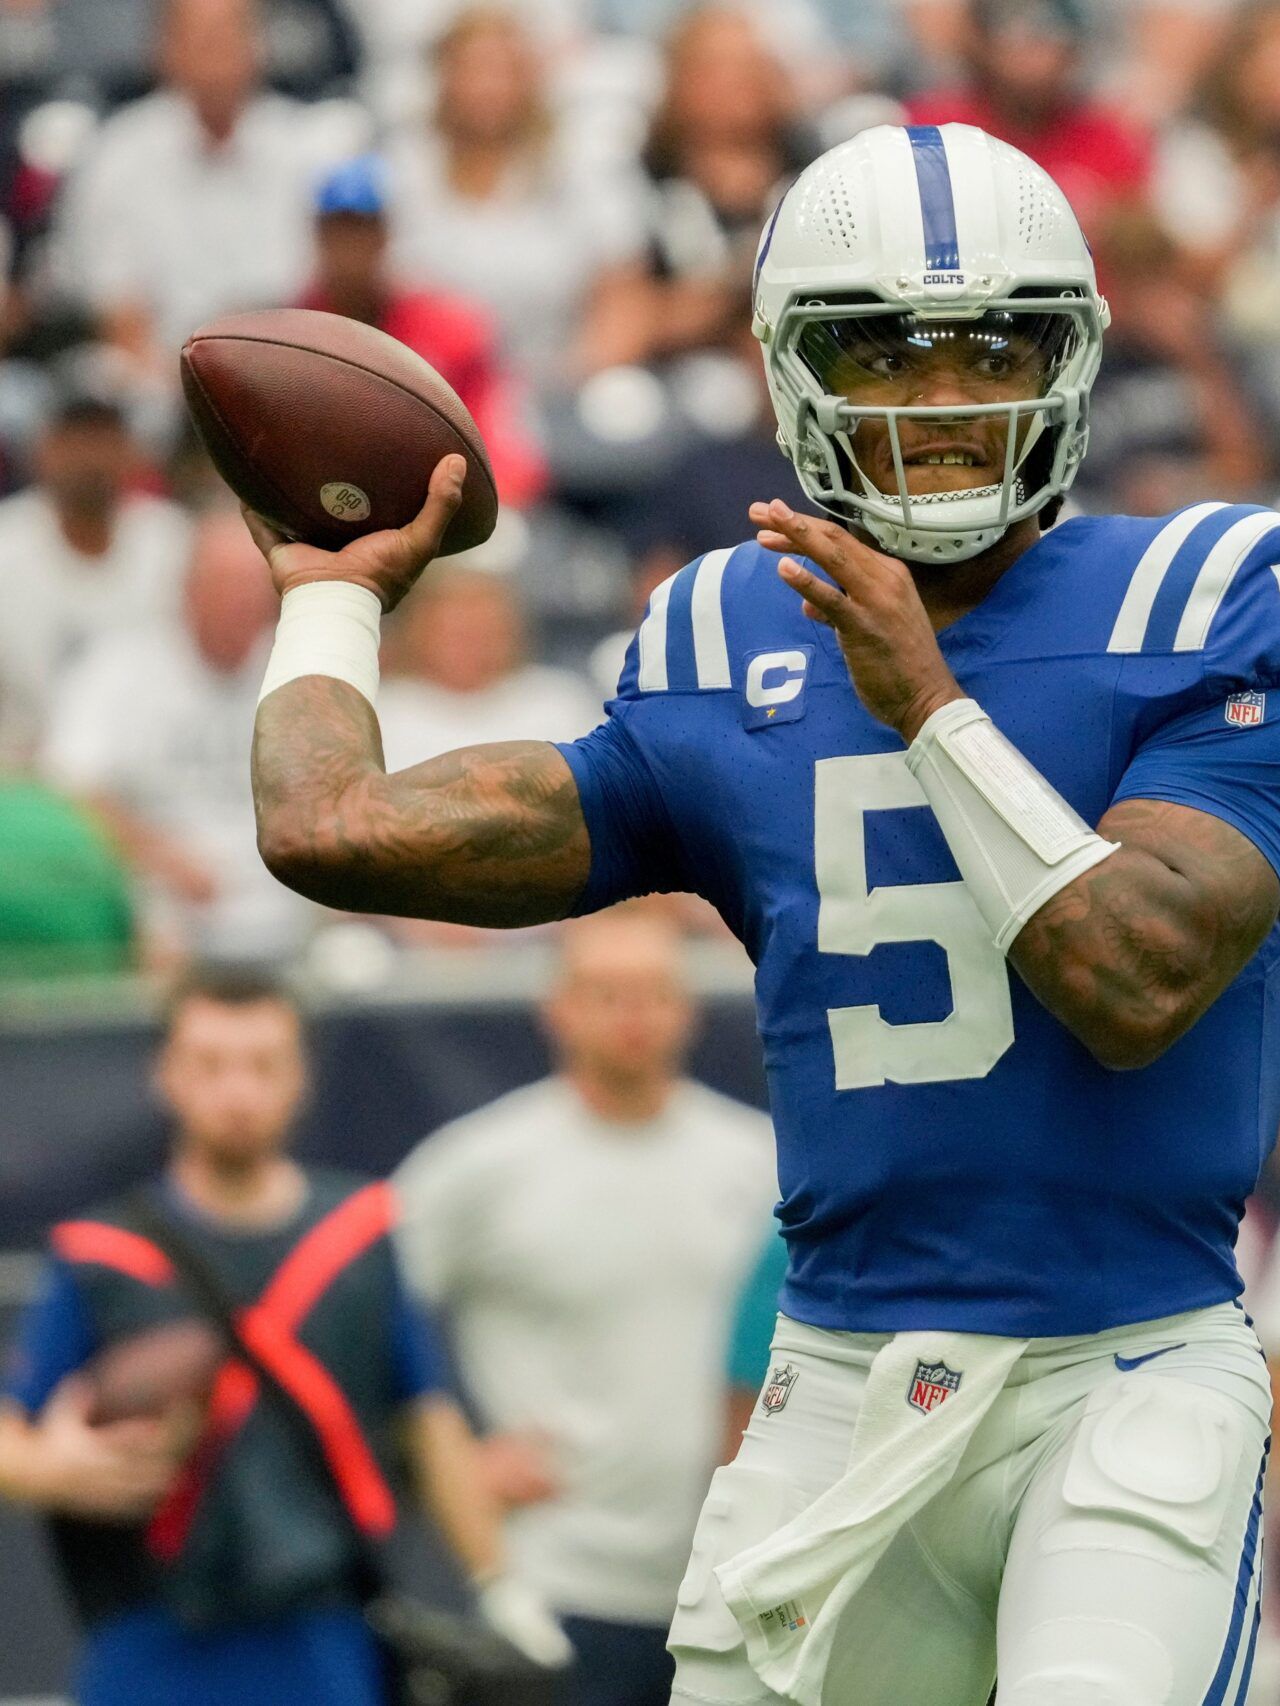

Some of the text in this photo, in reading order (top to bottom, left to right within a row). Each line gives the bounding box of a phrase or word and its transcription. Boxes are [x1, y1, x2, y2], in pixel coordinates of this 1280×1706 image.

[923, 274, 965, 285] COLTS
[745, 650, 807, 708] C
[1229, 702, 1260, 723] NFL
[814, 748, 1016, 1091] 5
